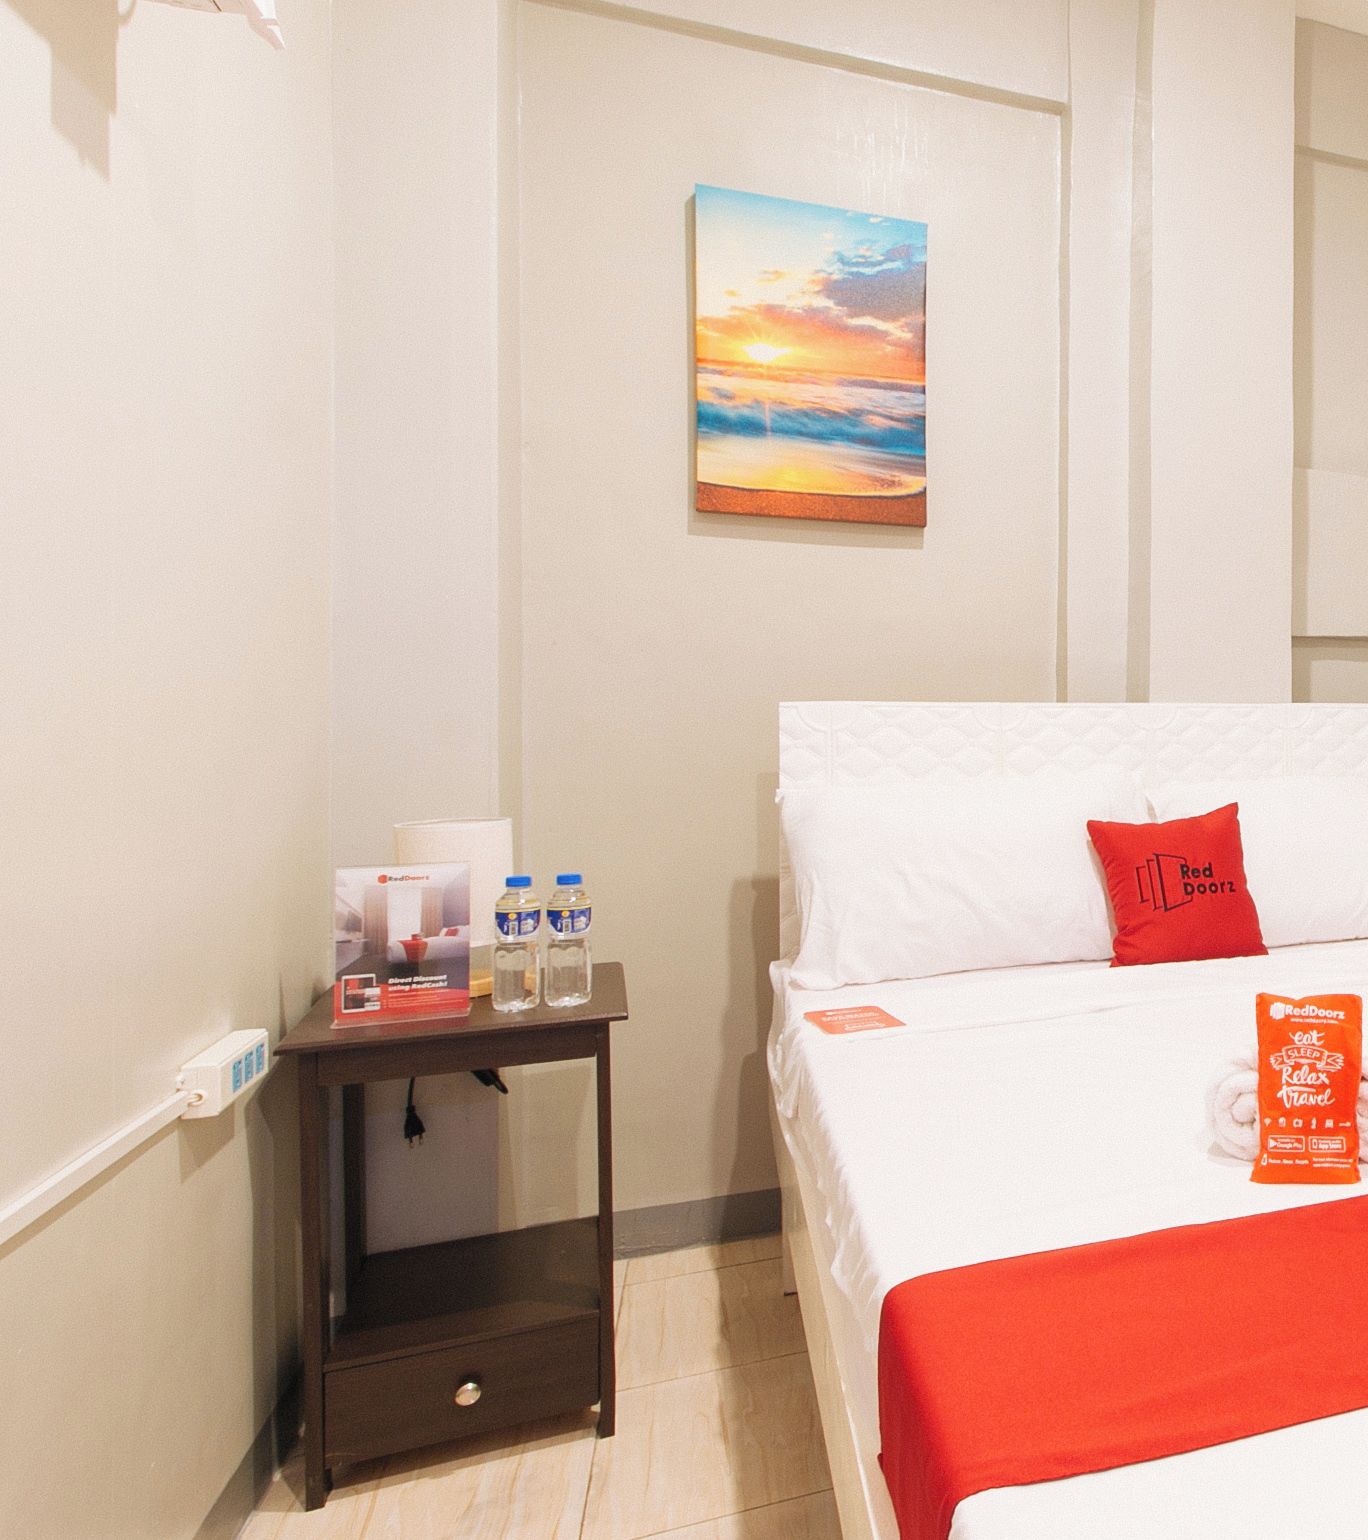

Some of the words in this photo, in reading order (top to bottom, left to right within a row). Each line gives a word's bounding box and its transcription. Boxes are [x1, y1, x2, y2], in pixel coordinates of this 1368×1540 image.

[1179, 862, 1214, 880] Red
[1182, 881, 1237, 896] Doorz
[1285, 1004, 1345, 1020] RedDoorz
[1288, 1029, 1325, 1047] eat
[1287, 1047, 1321, 1059] SLEEP
[1281, 1064, 1330, 1085] Relax
